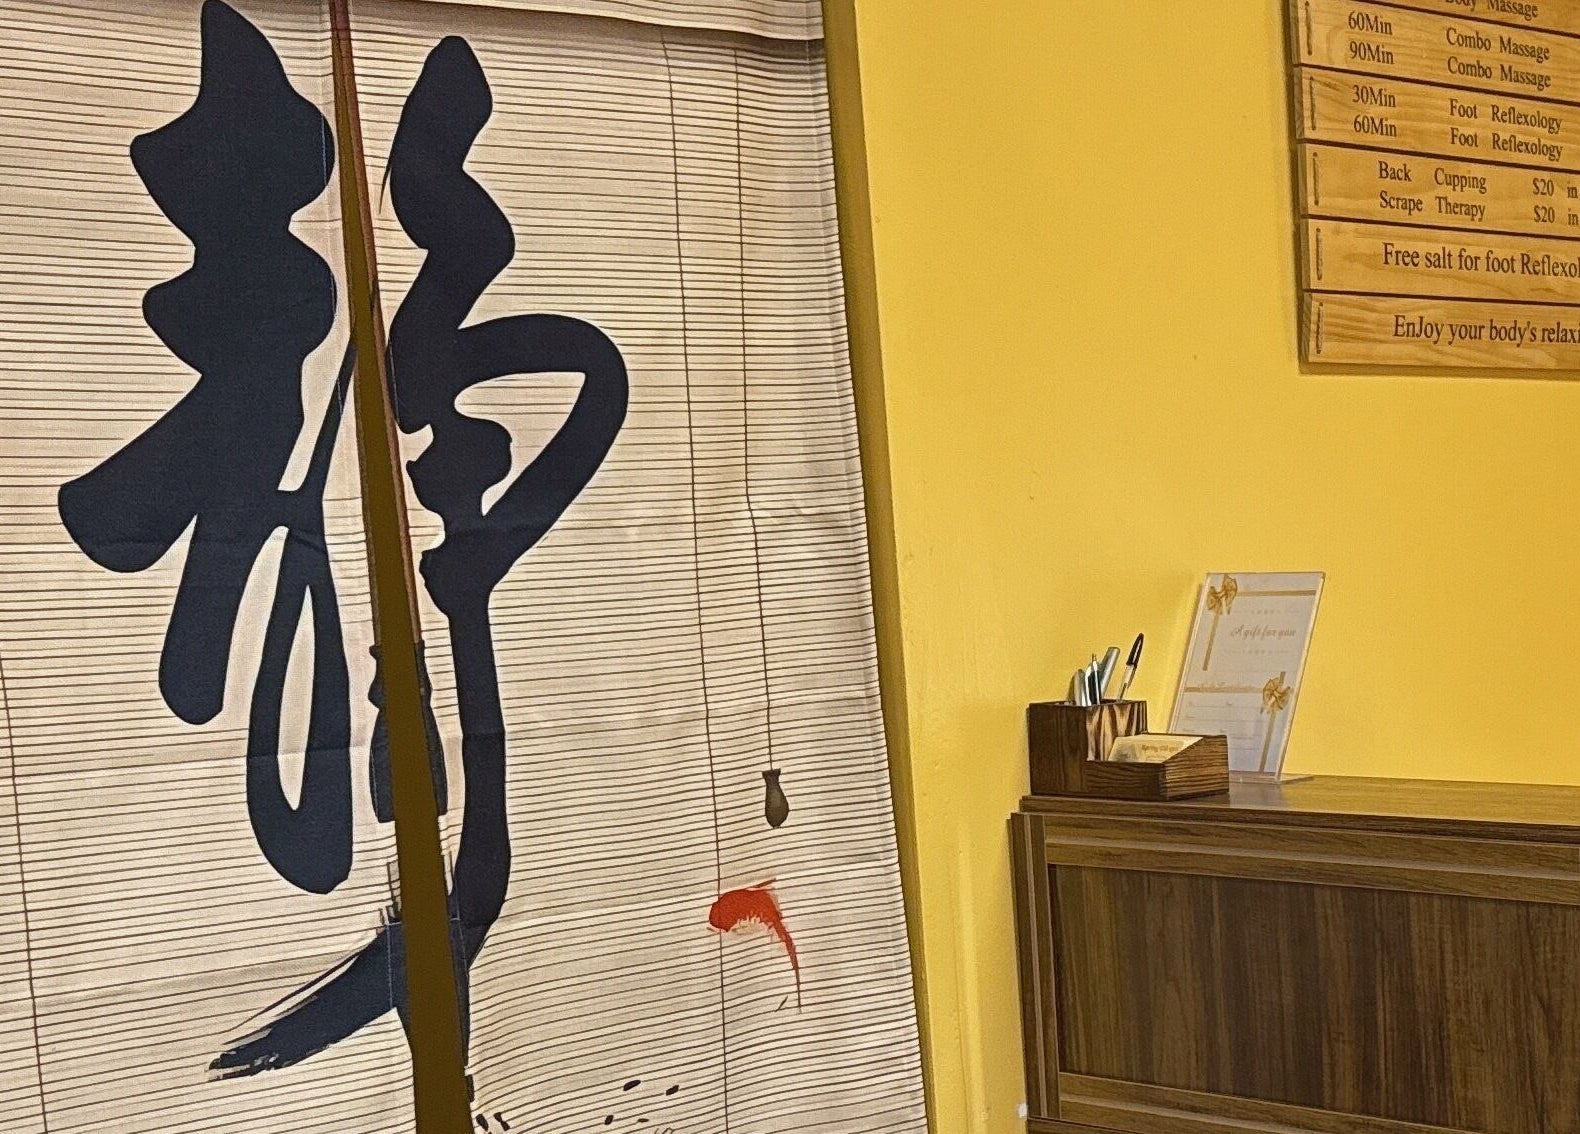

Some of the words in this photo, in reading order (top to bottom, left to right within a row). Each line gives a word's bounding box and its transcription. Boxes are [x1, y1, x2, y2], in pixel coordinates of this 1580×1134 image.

[1488, 0, 1538, 20] Massage
[1348, 12, 1393, 36] 60Min
[1446, 28, 1492, 51] Combo
[1499, 35, 1551, 63] Massage
[1349, 41, 1394, 65] 90Min
[1447, 56, 1493, 79] Combo
[1499, 63, 1552, 89] Massage
[1352, 85, 1396, 108] 30Min
[1449, 99, 1478, 120] Foot
[1491, 104, 1562, 134] Reflexology
[1353, 115, 1397, 137] 60Min
[1450, 127, 1479, 148] Foot
[1492, 133, 1563, 161] Reflexology
[1378, 161, 1412, 182] Back
[1434, 168, 1487, 194] Cupping
[1532, 179, 1555, 196] $20
[1567, 181, 1579, 198] in
[1379, 191, 1423, 215] Scrape
[1435, 196, 1486, 222] Therapy
[1533, 206, 1555, 224] $20
[1568, 208, 1580, 225] in
[1383, 243, 1421, 267] Free
[1424, 247, 1453, 270] salt
[1457, 248, 1480, 272] for
[1485, 250, 1516, 273] foot
[1447, 320, 1487, 345] your
[1488, 319, 1537, 346] body's
